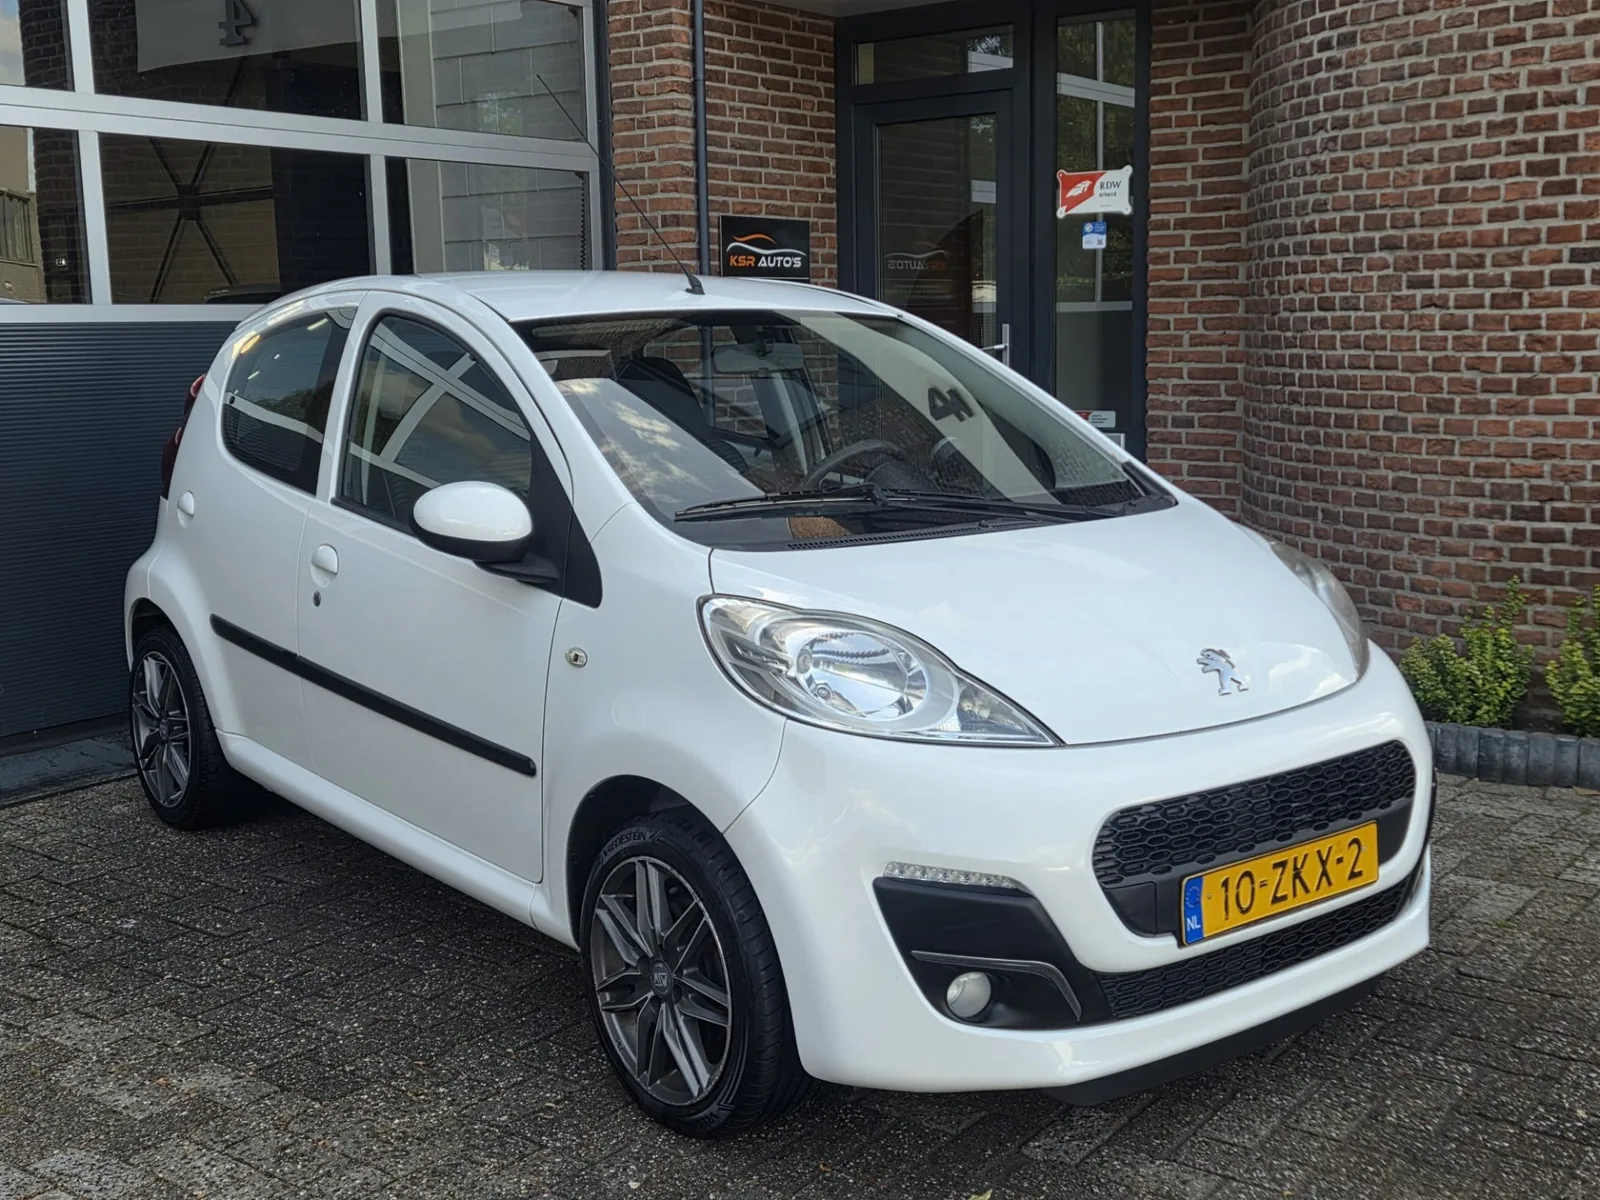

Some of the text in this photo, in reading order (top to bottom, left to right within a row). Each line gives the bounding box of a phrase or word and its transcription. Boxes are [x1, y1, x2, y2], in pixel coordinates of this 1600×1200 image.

[1099, 180, 1122, 190] RDW
[729, 255, 802, 268] KSR AUTO'S
[1220, 837, 1364, 921] 10-ZKX-2
[1186, 914, 1202, 932] NL
